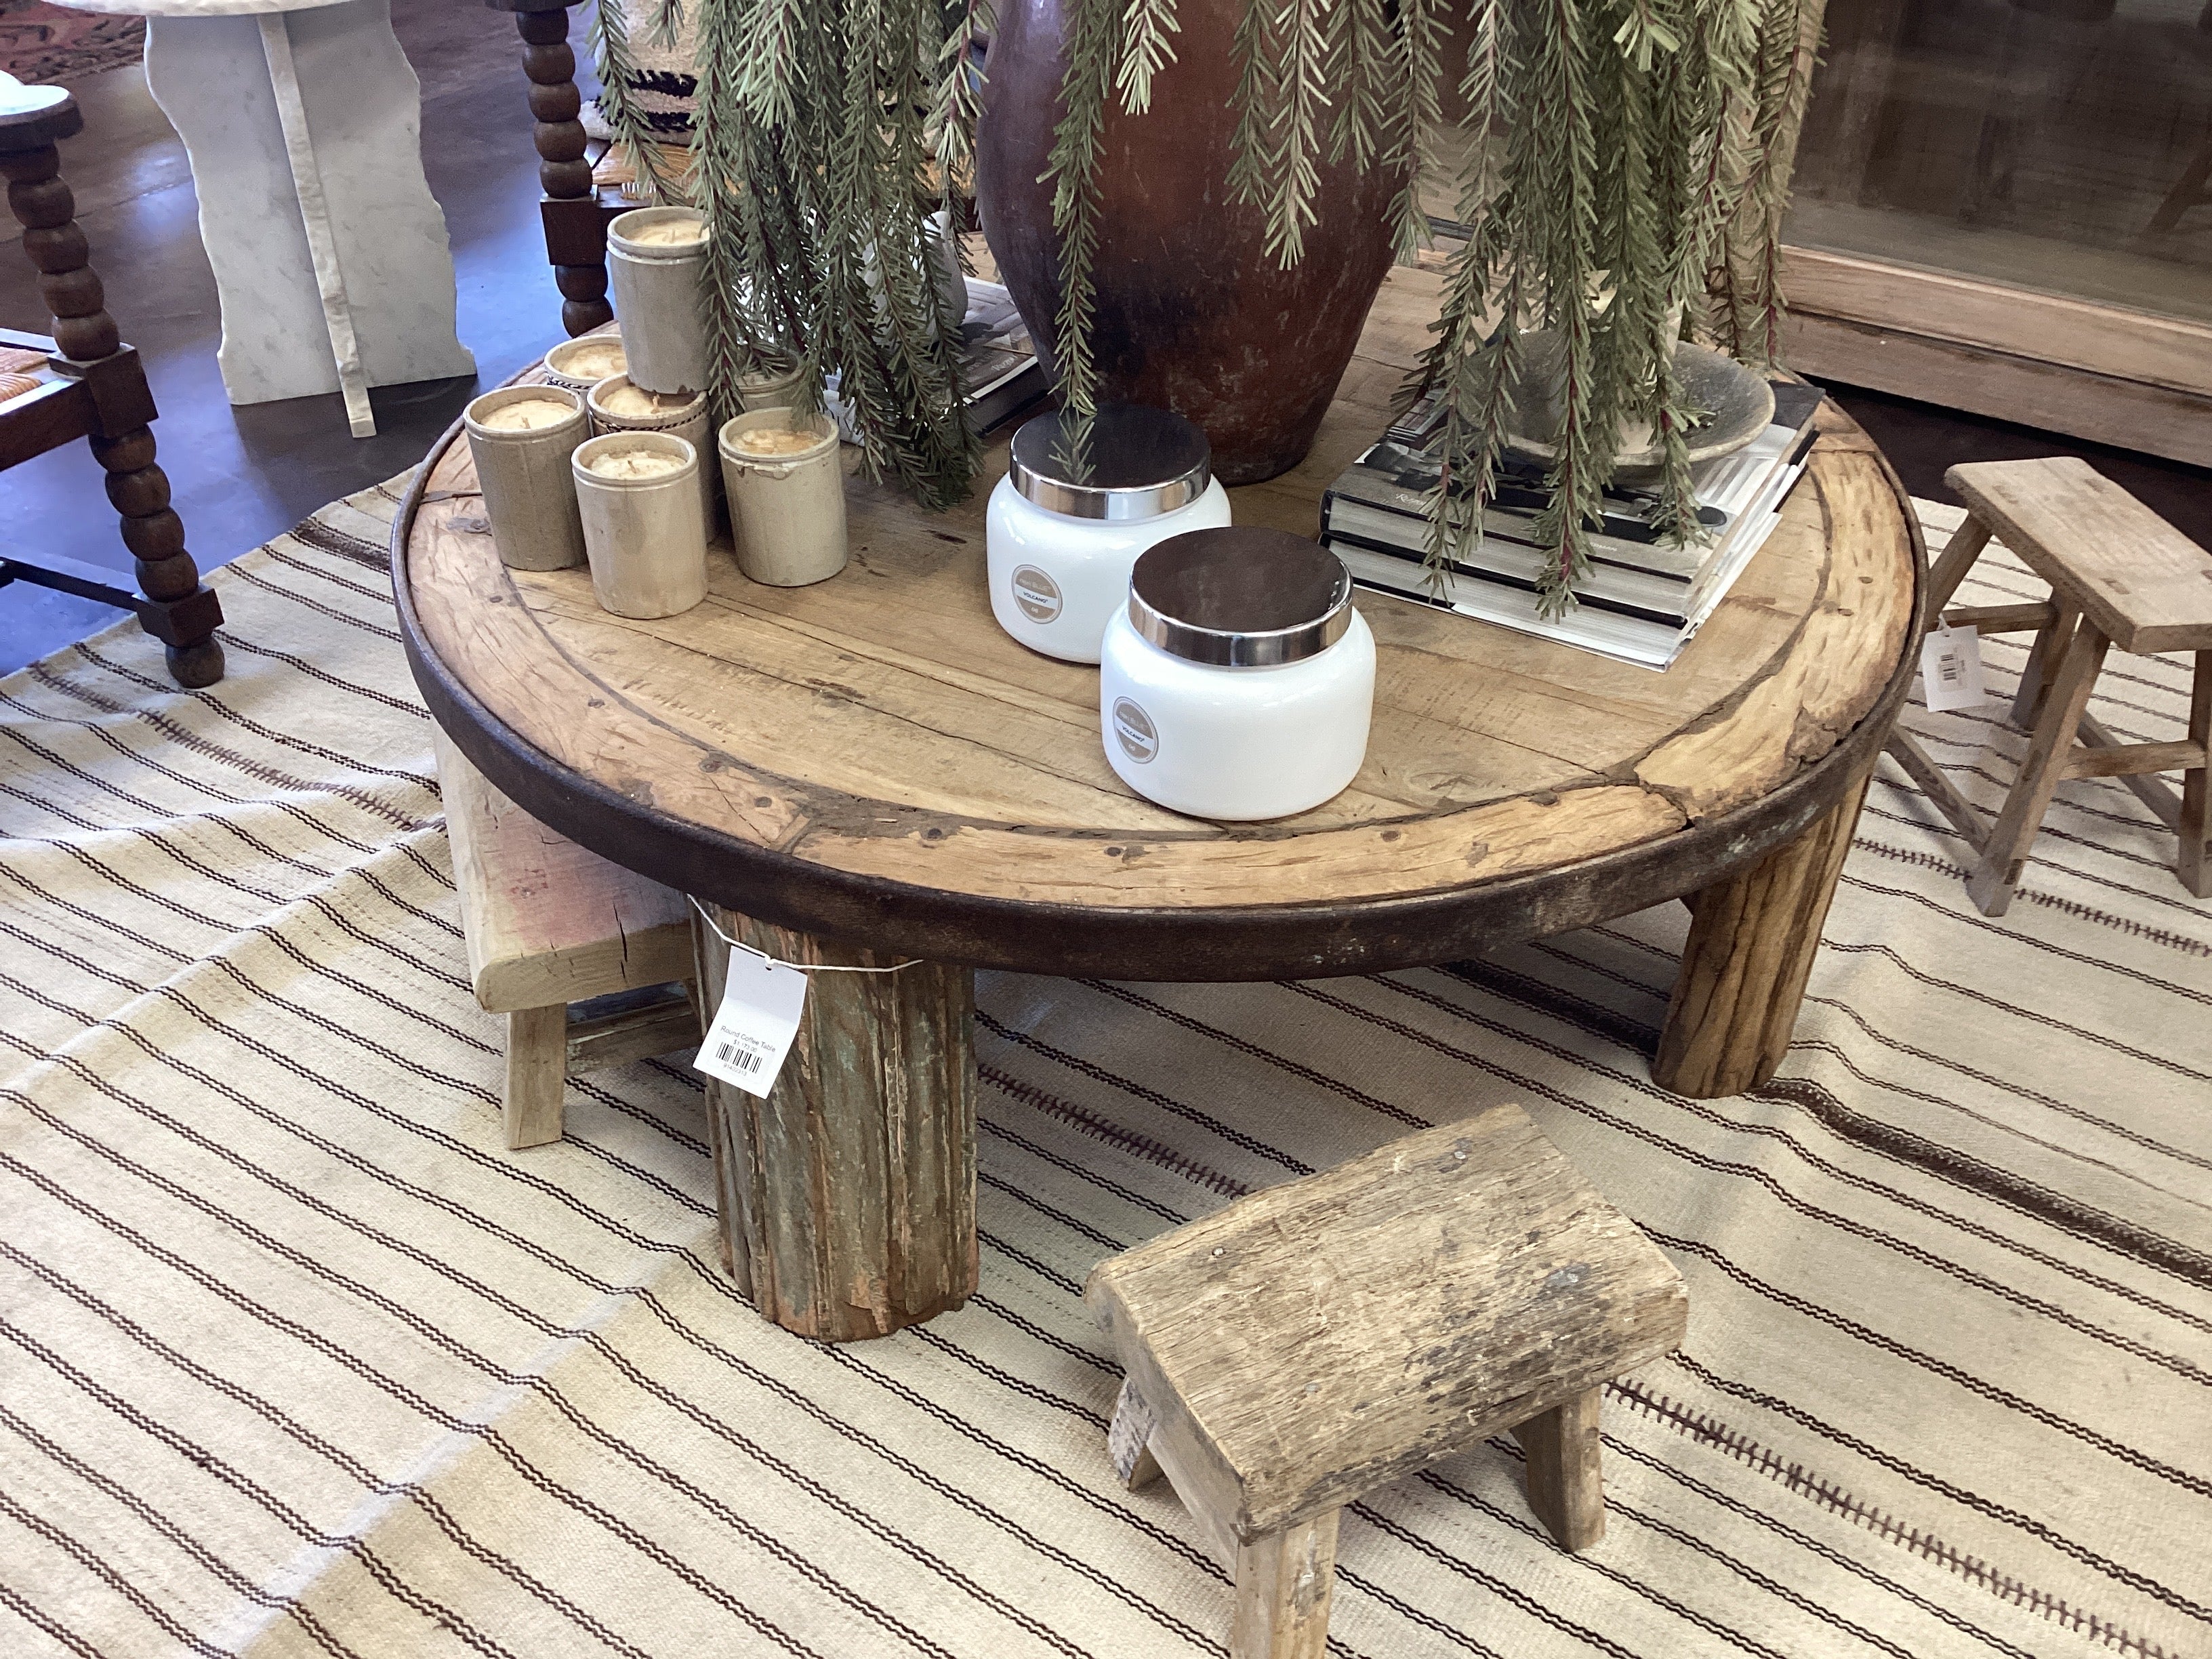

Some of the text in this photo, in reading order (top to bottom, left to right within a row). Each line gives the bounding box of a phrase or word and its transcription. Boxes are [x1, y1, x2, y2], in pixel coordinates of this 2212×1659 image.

[720, 1025, 776, 1052] Round Coffee Table
